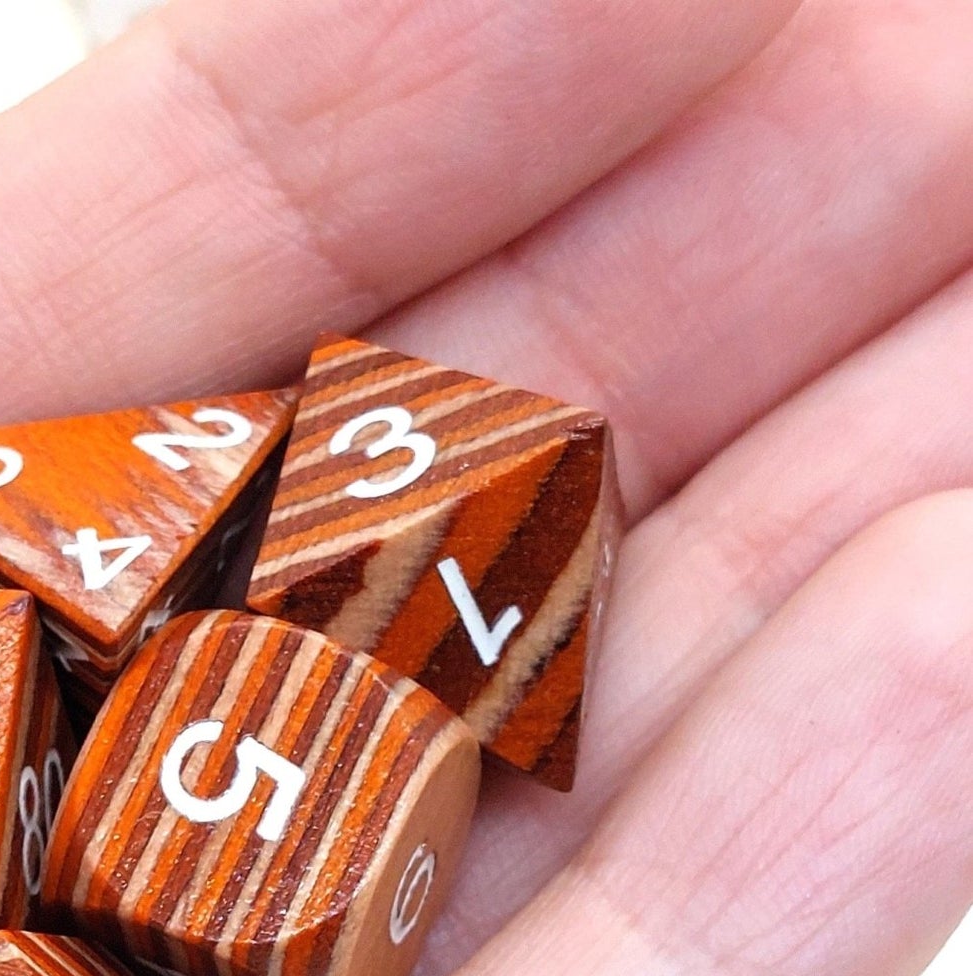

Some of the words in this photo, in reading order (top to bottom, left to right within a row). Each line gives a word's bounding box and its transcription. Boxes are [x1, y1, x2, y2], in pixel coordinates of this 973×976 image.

[133, 408, 252, 472] 2
[329, 406, 436, 498] 3
[61, 528, 152, 590] 4
[161, 719, 306, 842] 5
